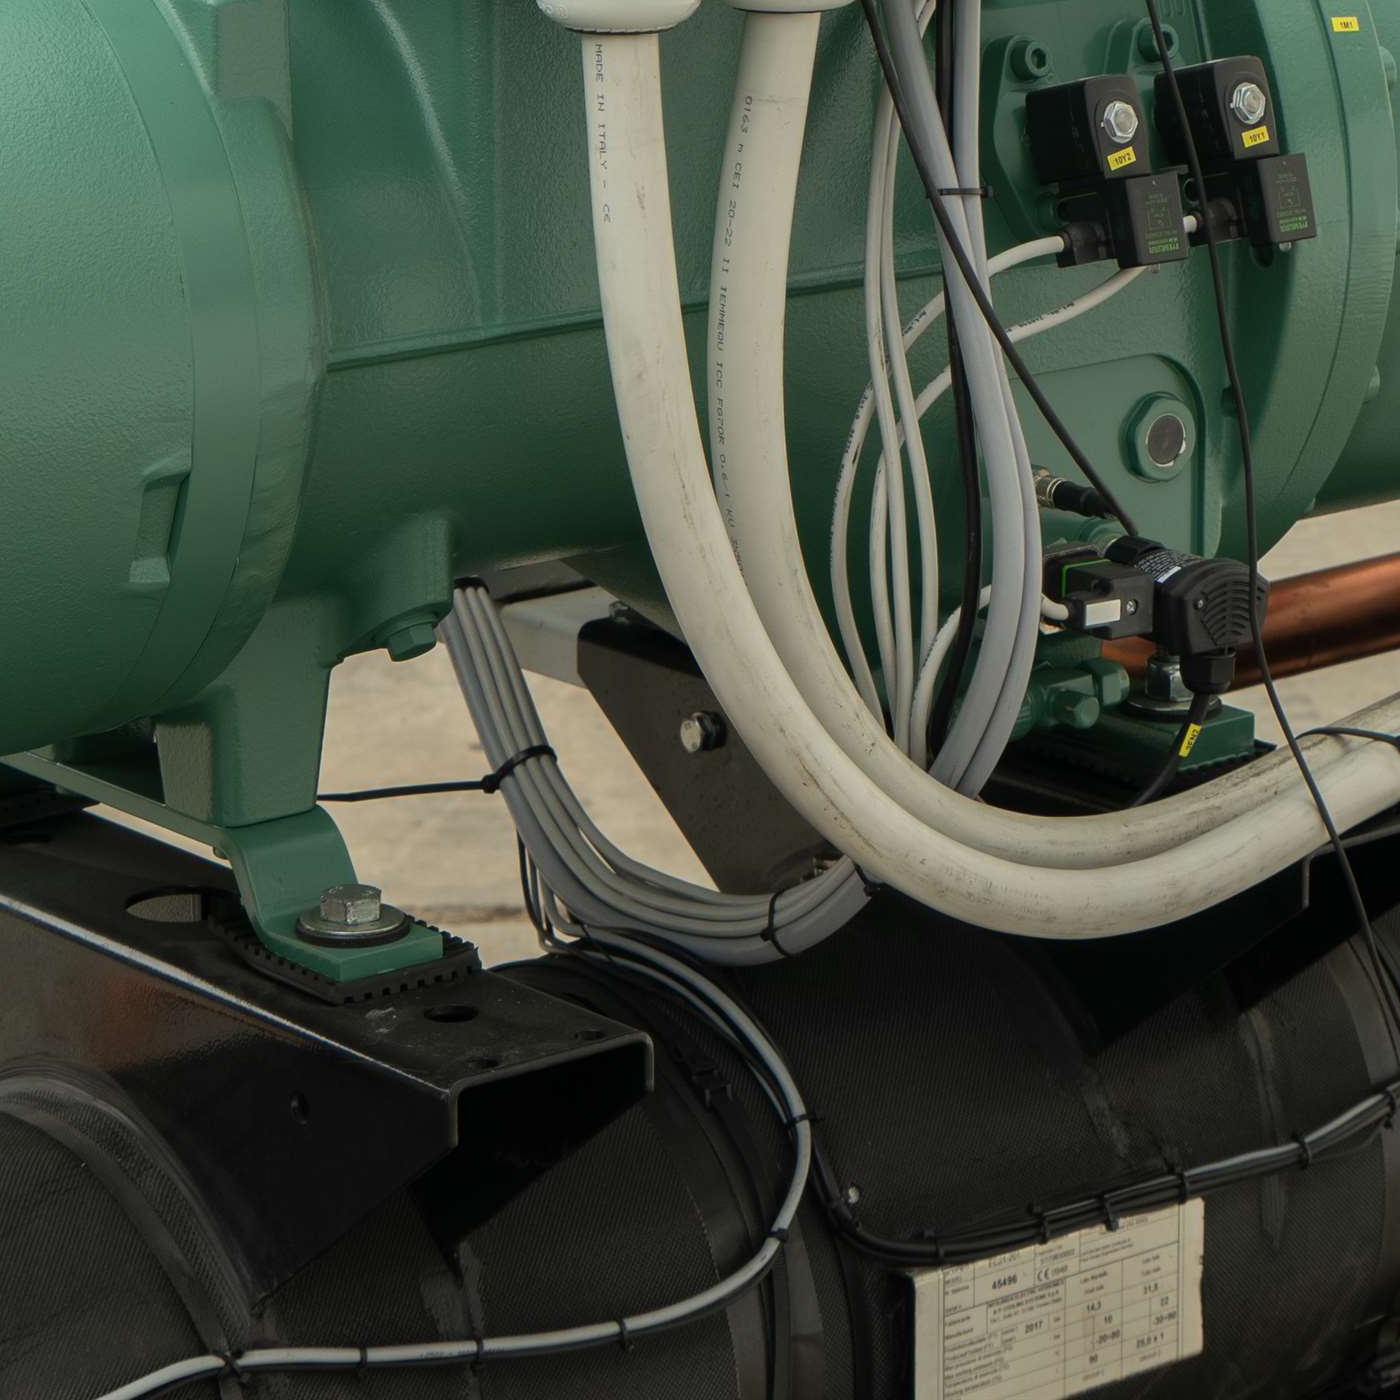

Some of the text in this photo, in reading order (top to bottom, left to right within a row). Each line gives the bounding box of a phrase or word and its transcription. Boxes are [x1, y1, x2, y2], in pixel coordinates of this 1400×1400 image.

[594, 43, 604, 83] MADE
[596, 94, 606, 112] IN
[597, 123, 608, 170] ITALY
[724, 199, 737, 248] 20-22
[1024, 1319, 1044, 1335] 2017
